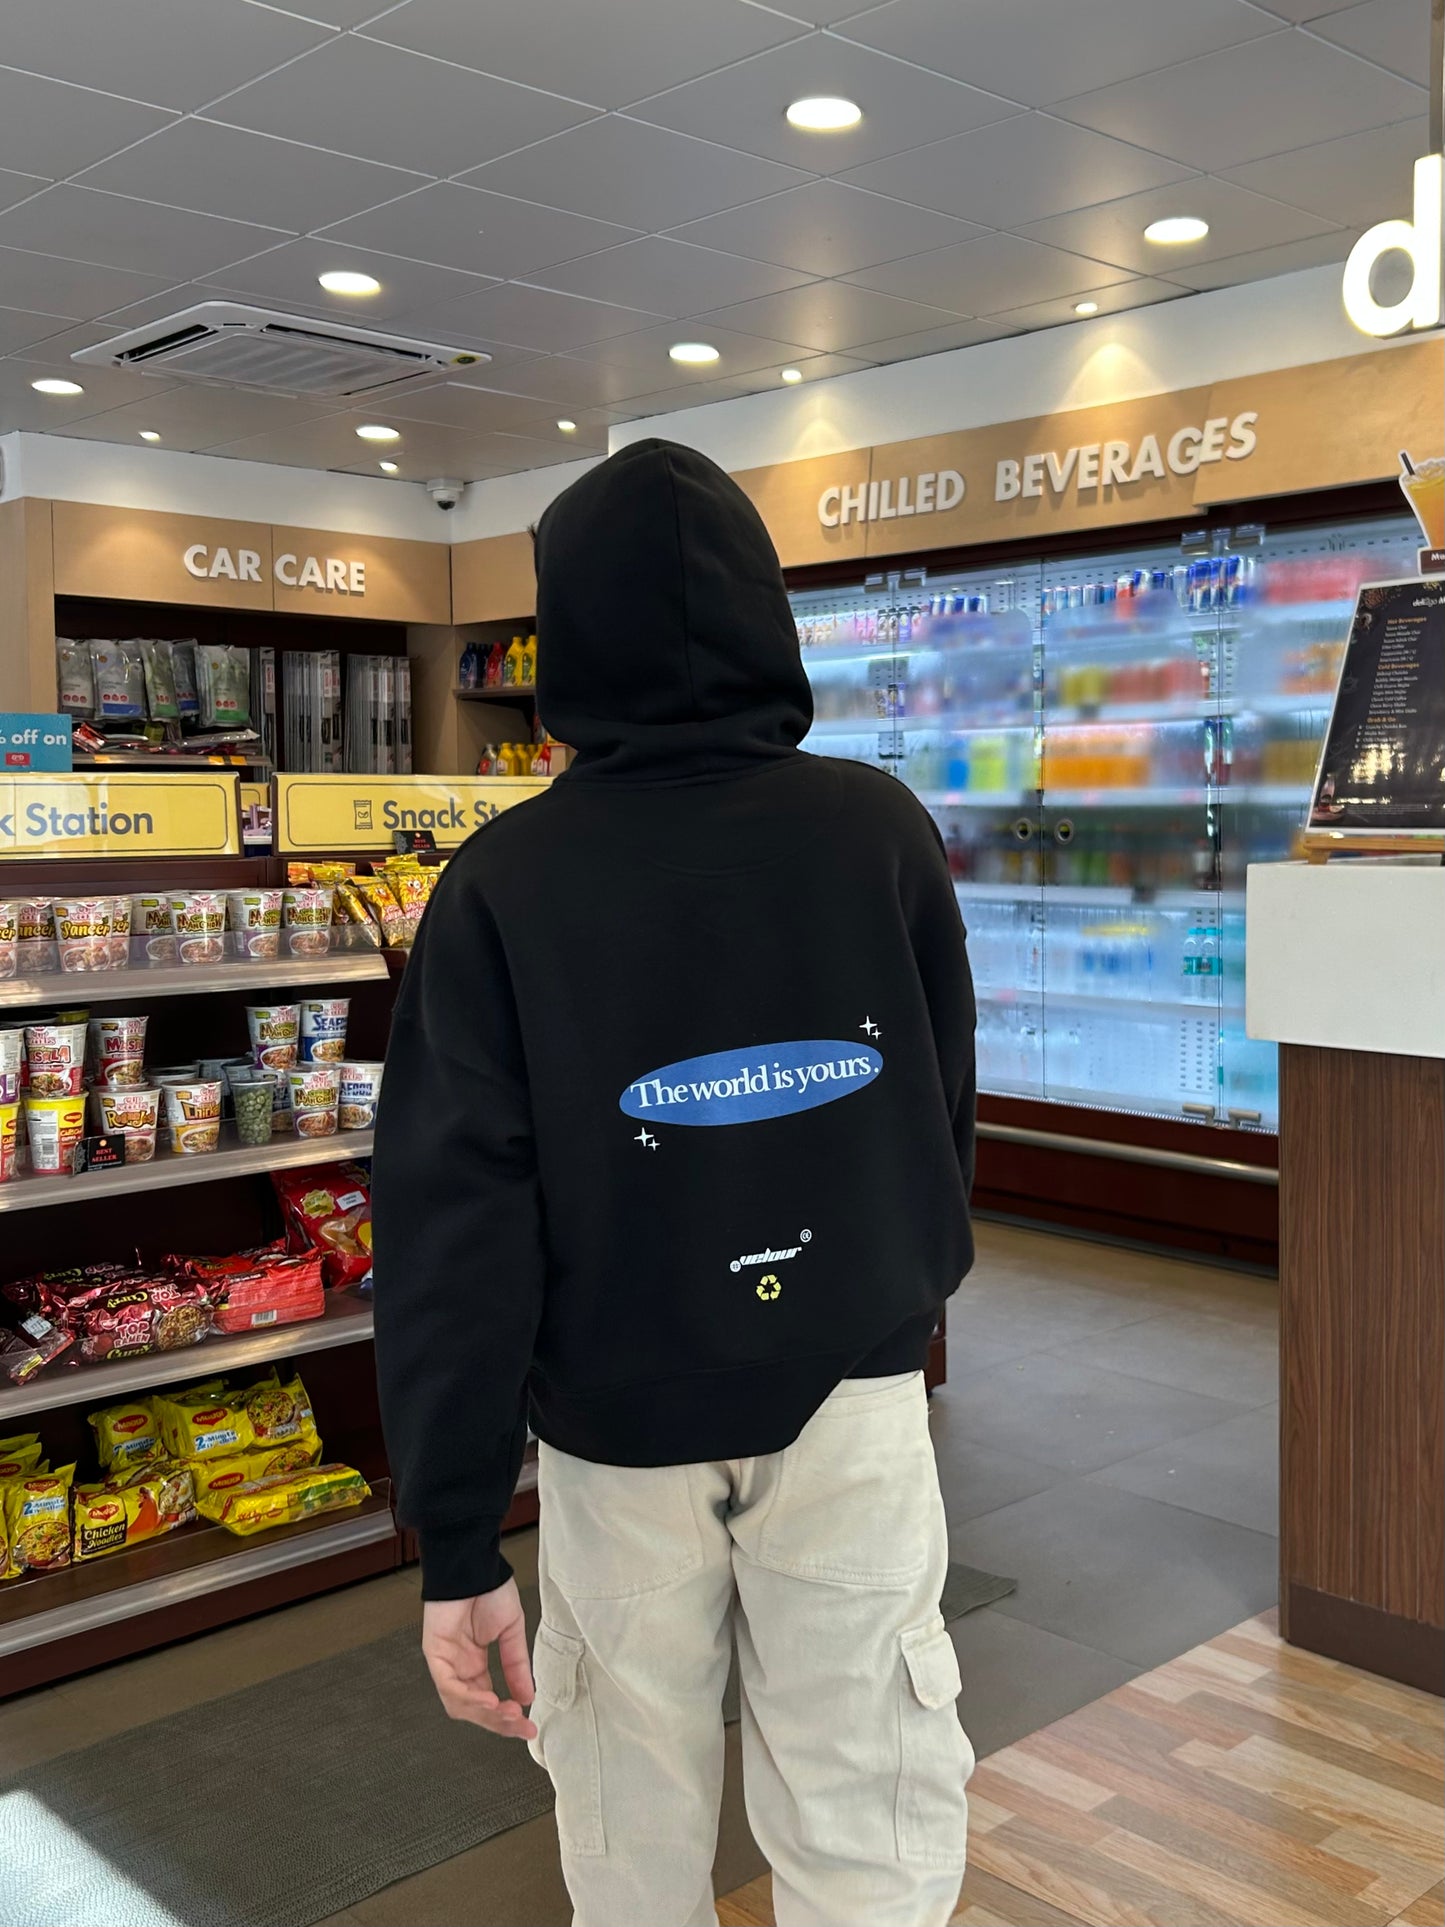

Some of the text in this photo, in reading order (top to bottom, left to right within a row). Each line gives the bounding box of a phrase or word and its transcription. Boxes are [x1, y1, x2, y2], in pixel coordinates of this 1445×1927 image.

[1343, 154, 1442, 337] d
[817, 412, 1258, 527] CHILLED BEVERAGES
[184, 544, 366, 595] CAR CARE
[11, 728, 39, 745] off
[43, 734, 67, 745] on
[26, 802, 153, 836] Station
[383, 797, 467, 830] Snack
[630, 1056, 879, 1108] The world is yours.
[106, 1291, 148, 1309] Curry
[114, 1334, 150, 1349] RAMEN
[116, 1321, 150, 1338] TOP
[84, 1523, 126, 1541] Chicken
[87, 1534, 123, 1549] Noodles
